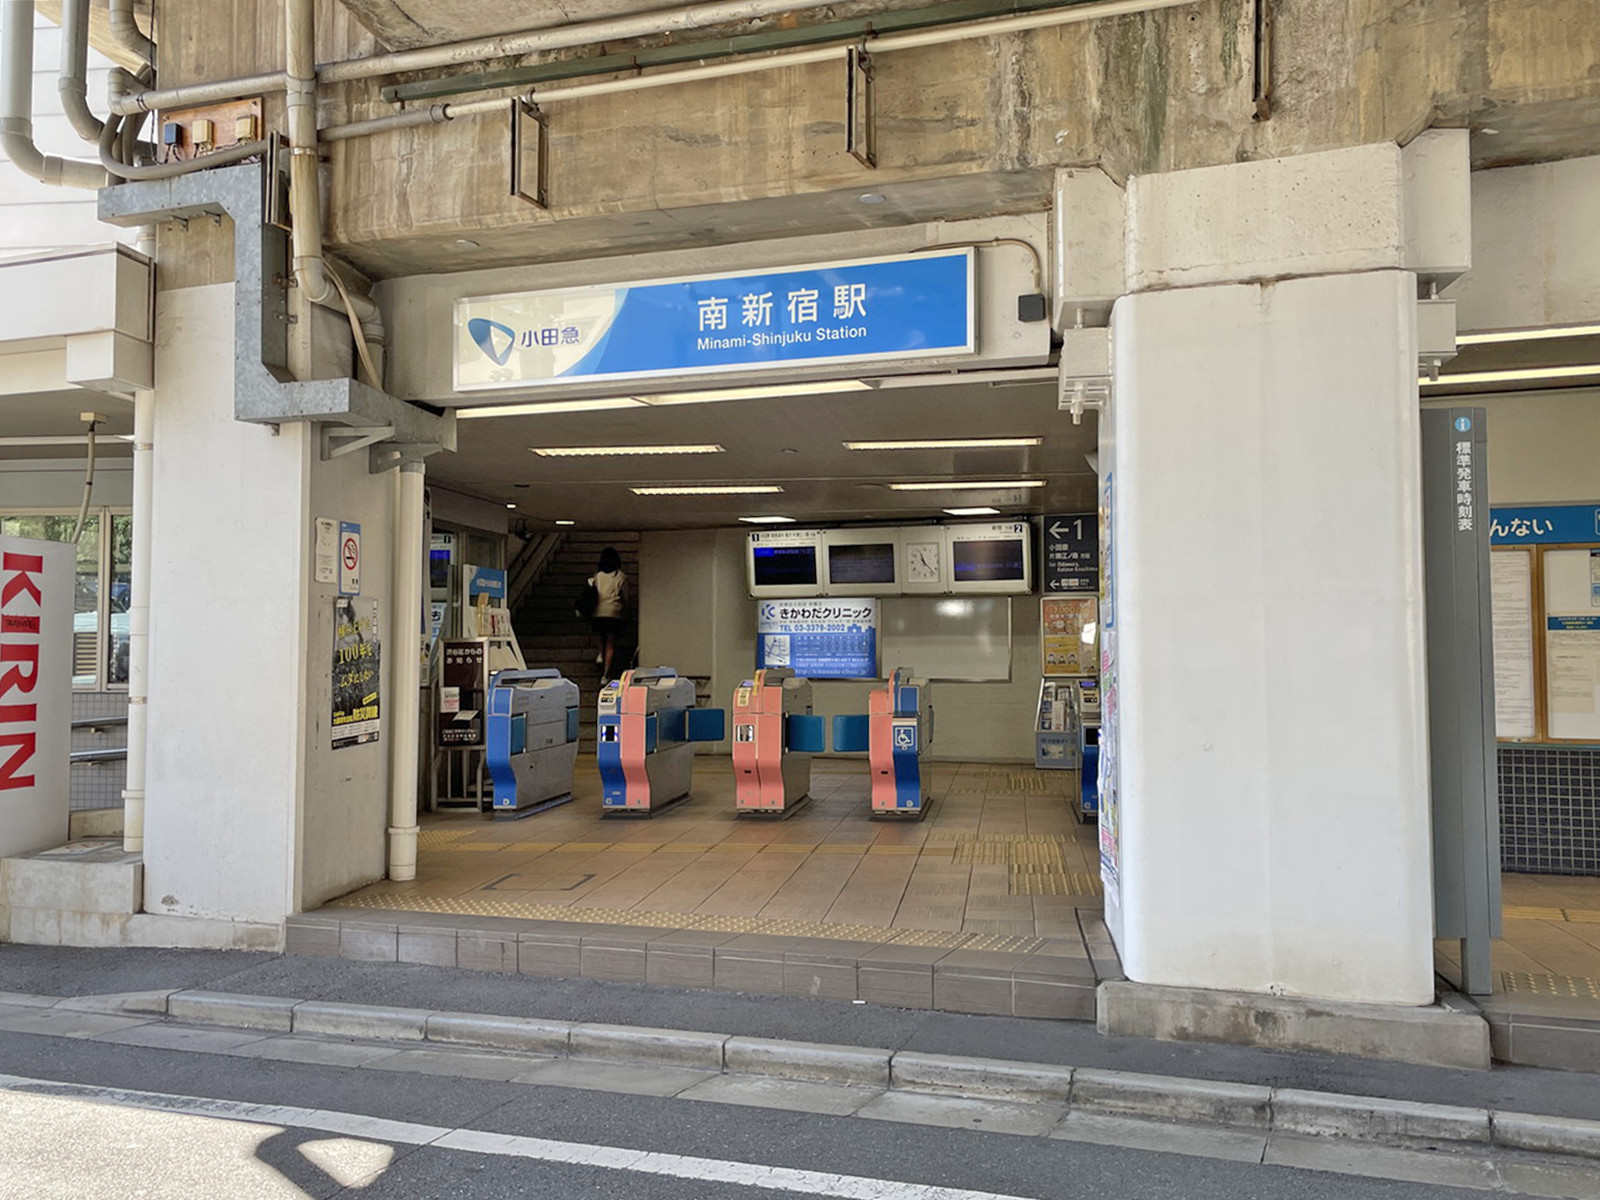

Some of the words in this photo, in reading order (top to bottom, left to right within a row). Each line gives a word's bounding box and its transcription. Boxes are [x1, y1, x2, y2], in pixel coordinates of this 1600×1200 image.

[697, 283, 867, 332] 南新宿駅
[521, 327, 580, 348] 小田急
[697, 330, 812, 351] Minami-Shinjuku
[816, 326, 867, 341] Station
[1456, 441, 1473, 531] 標準発車時刻表
[1073, 519, 1082, 540] 1
[1490, 518, 1553, 537] んない
[780, 606, 872, 619] きかわだクリニック
[780, 624, 792, 632] TEL
[0, 552, 43, 790] KIRIN
